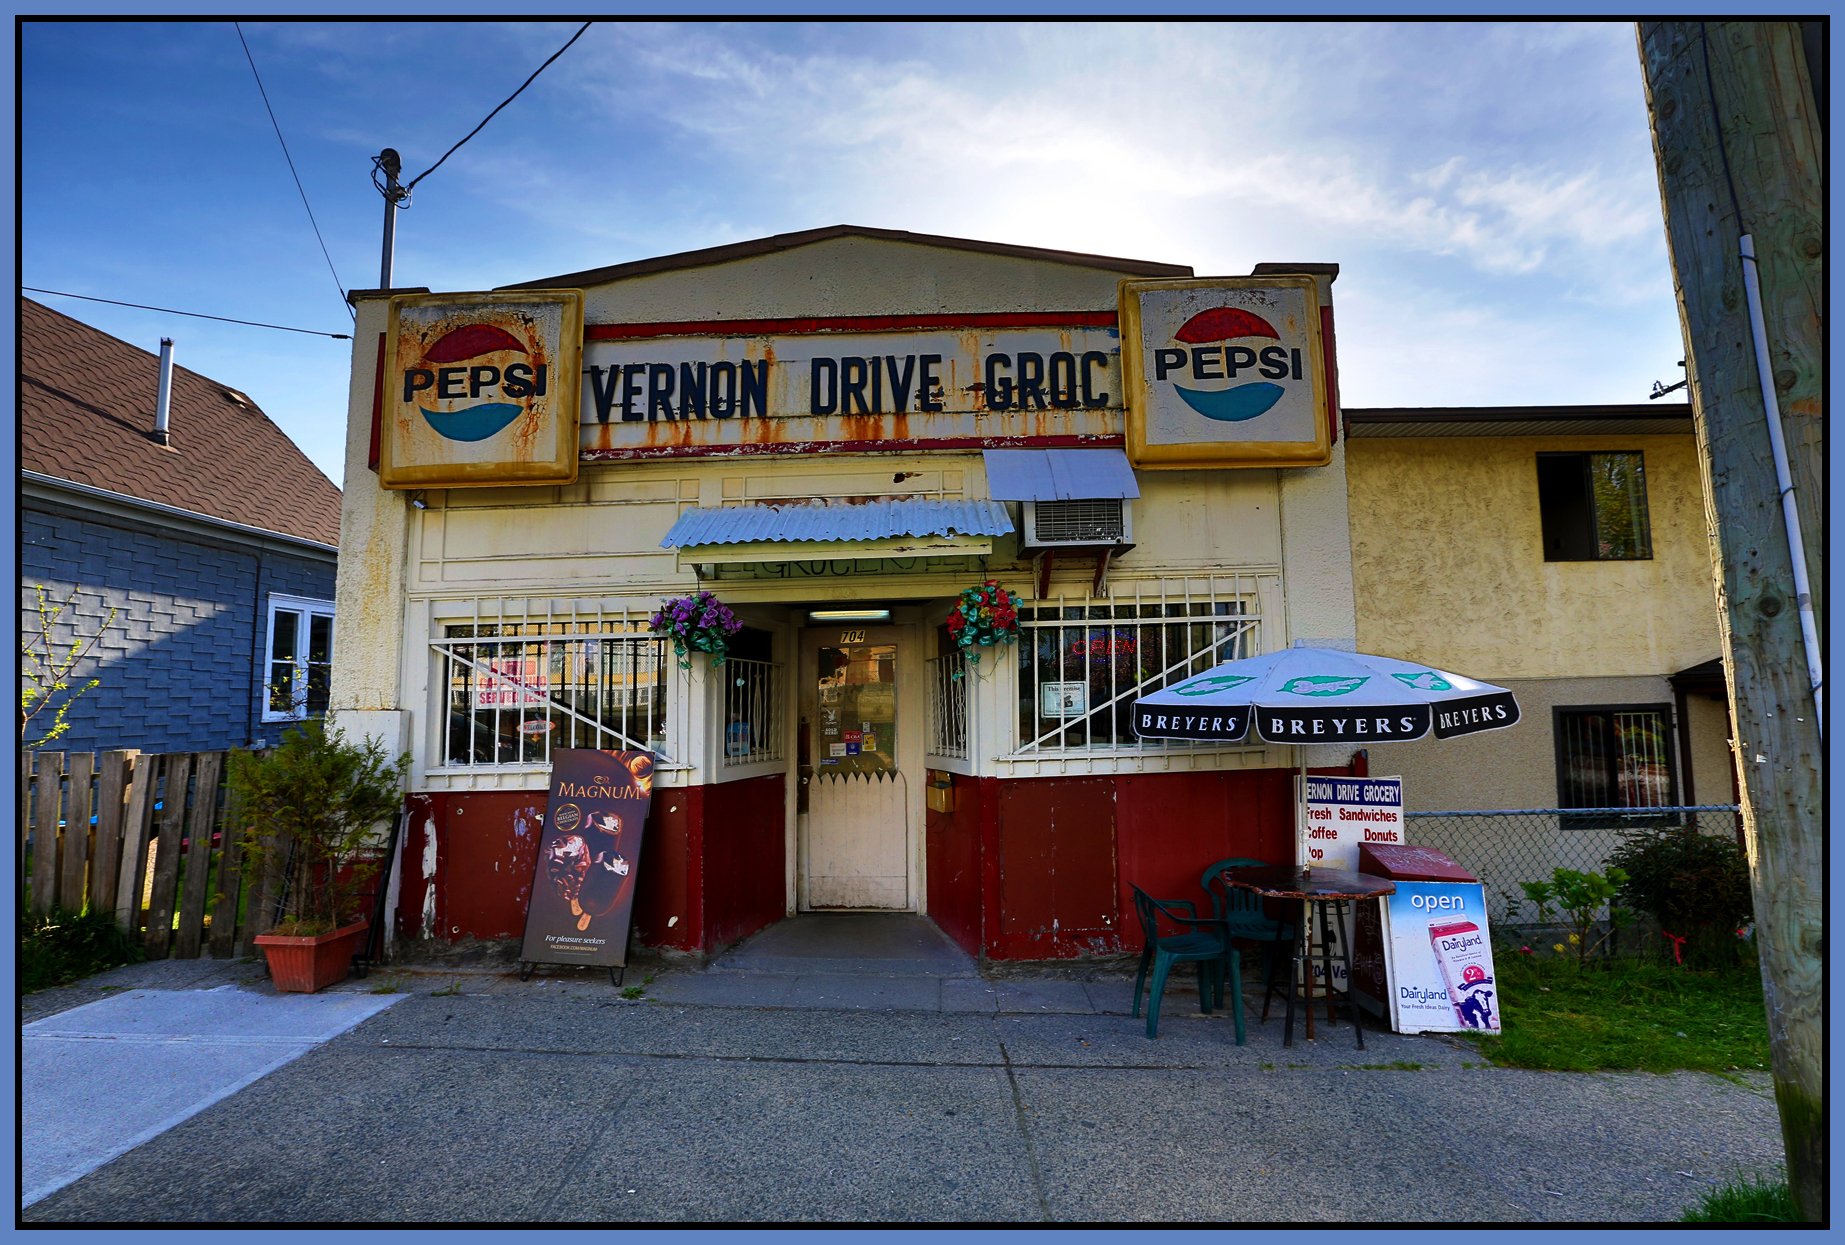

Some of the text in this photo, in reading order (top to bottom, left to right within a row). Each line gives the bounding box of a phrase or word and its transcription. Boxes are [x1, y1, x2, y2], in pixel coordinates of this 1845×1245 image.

[1155, 345, 1303, 380] PEPSI
[404, 362, 547, 402] PEPSI
[590, 350, 1110, 423] VERNON DRIVE GROC
[841, 630, 865, 642] 704
[1072, 639, 1137, 655] OPEN
[1142, 714, 1237, 731] BREYERS
[1440, 704, 1507, 729] BREYERS
[1272, 718, 1414, 735] BREYERS
[558, 781, 642, 800] MAGNUM
[1307, 782, 1399, 803] ERNON DRIVE GROCERY
[1339, 807, 1398, 822] Sandwiches
[1364, 828, 1398, 842] Donuts
[1308, 846, 1324, 860] op
[1411, 894, 1465, 913] open
[545, 934, 557, 942] For
[556, 935, 583, 943] pleasure
[1442, 934, 1482, 951] Dairyland
[1400, 986, 1448, 1004] Dairyland
